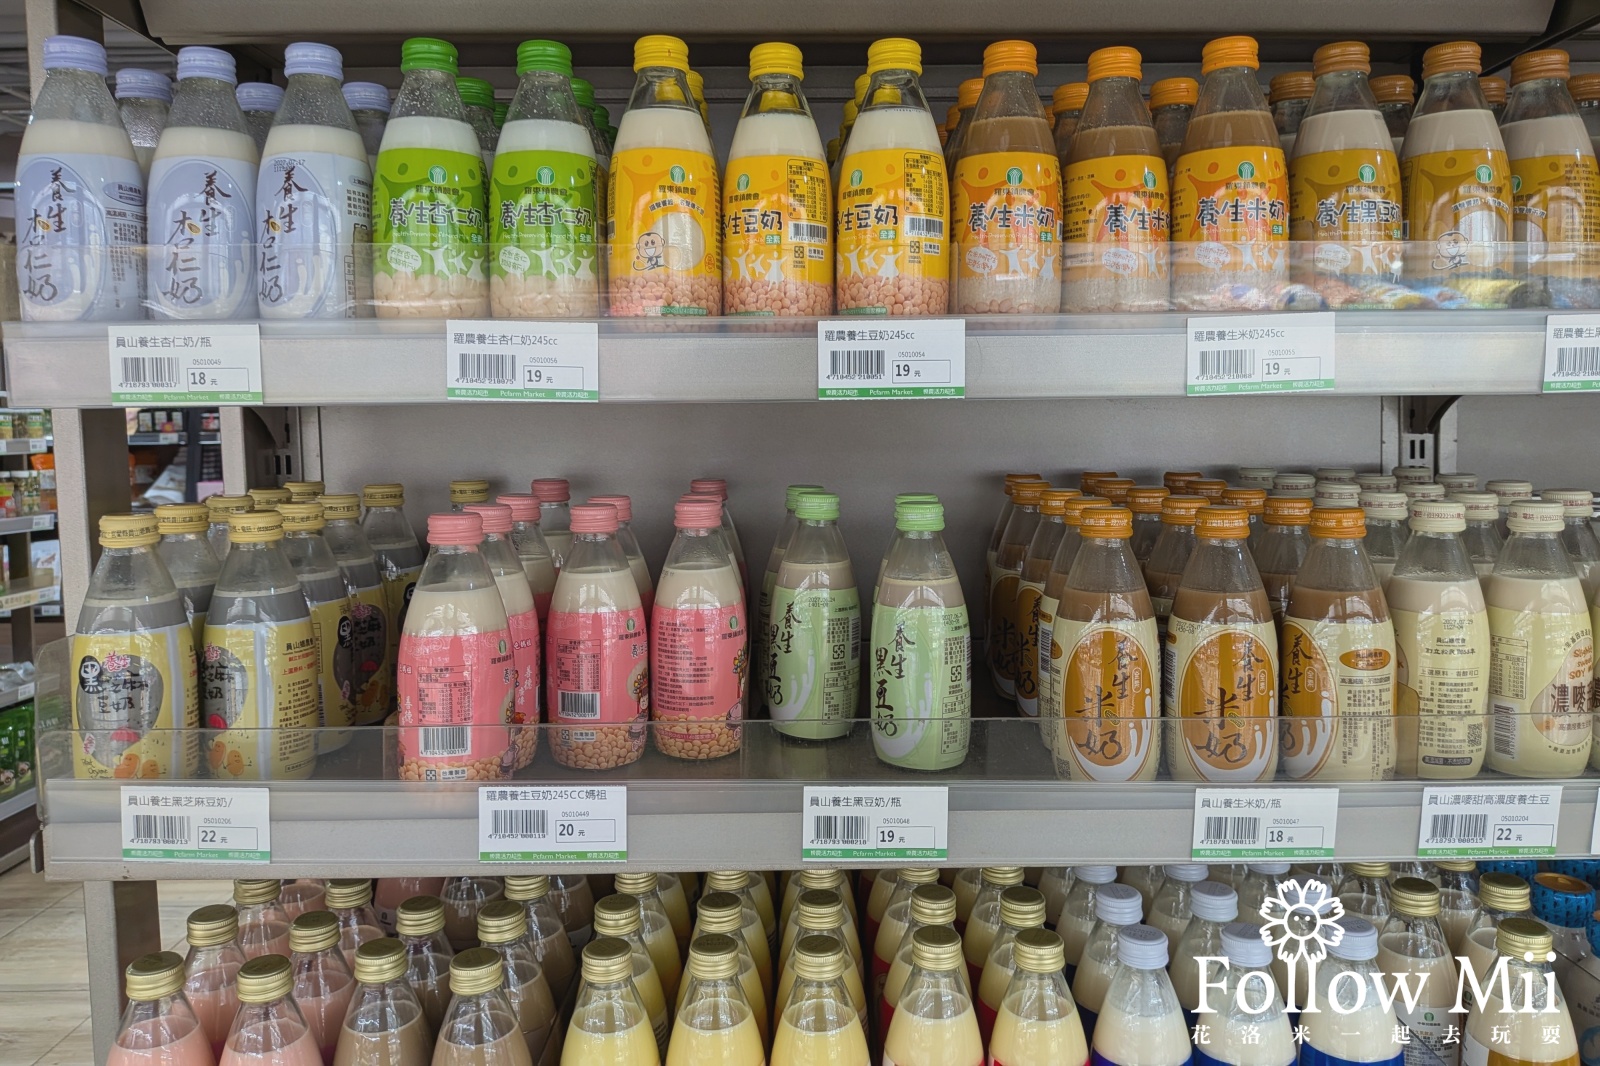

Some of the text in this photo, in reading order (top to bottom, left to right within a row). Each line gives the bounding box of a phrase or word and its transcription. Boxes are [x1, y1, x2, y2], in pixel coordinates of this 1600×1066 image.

[390, 198, 483, 228] 養生杏仁奶
[500, 200, 592, 228] 養生杏仁奶
[968, 202, 1055, 232] 養生米奶
[1198, 198, 1285, 227] 養生米奶
[880, 230, 896, 240] 全素
[116, 336, 212, 348] 員山養生杏仁奶/瓶
[454, 333, 558, 346] 羅農養生杏仁奶245cc
[825, 330, 915, 341] 羅農養生豆奶245cc
[1194, 329, 1285, 342] 羅農養生米奶245cc
[895, 364, 910, 377] 19
[1265, 362, 1280, 375] 19
[191, 372, 206, 385] 18
[527, 370, 542, 383] 19
[128, 796, 233, 808] 員山養生黑芝麻豆奶/
[810, 796, 902, 808] 員山養生黑豆奶/瓶
[1201, 798, 1282, 809] 員山養生米奶/瓶
[201, 830, 216, 843] 22
[559, 824, 574, 836] 20
[1497, 828, 1512, 841] 22
[880, 831, 895, 843] 19
[1269, 831, 1283, 843] 18
